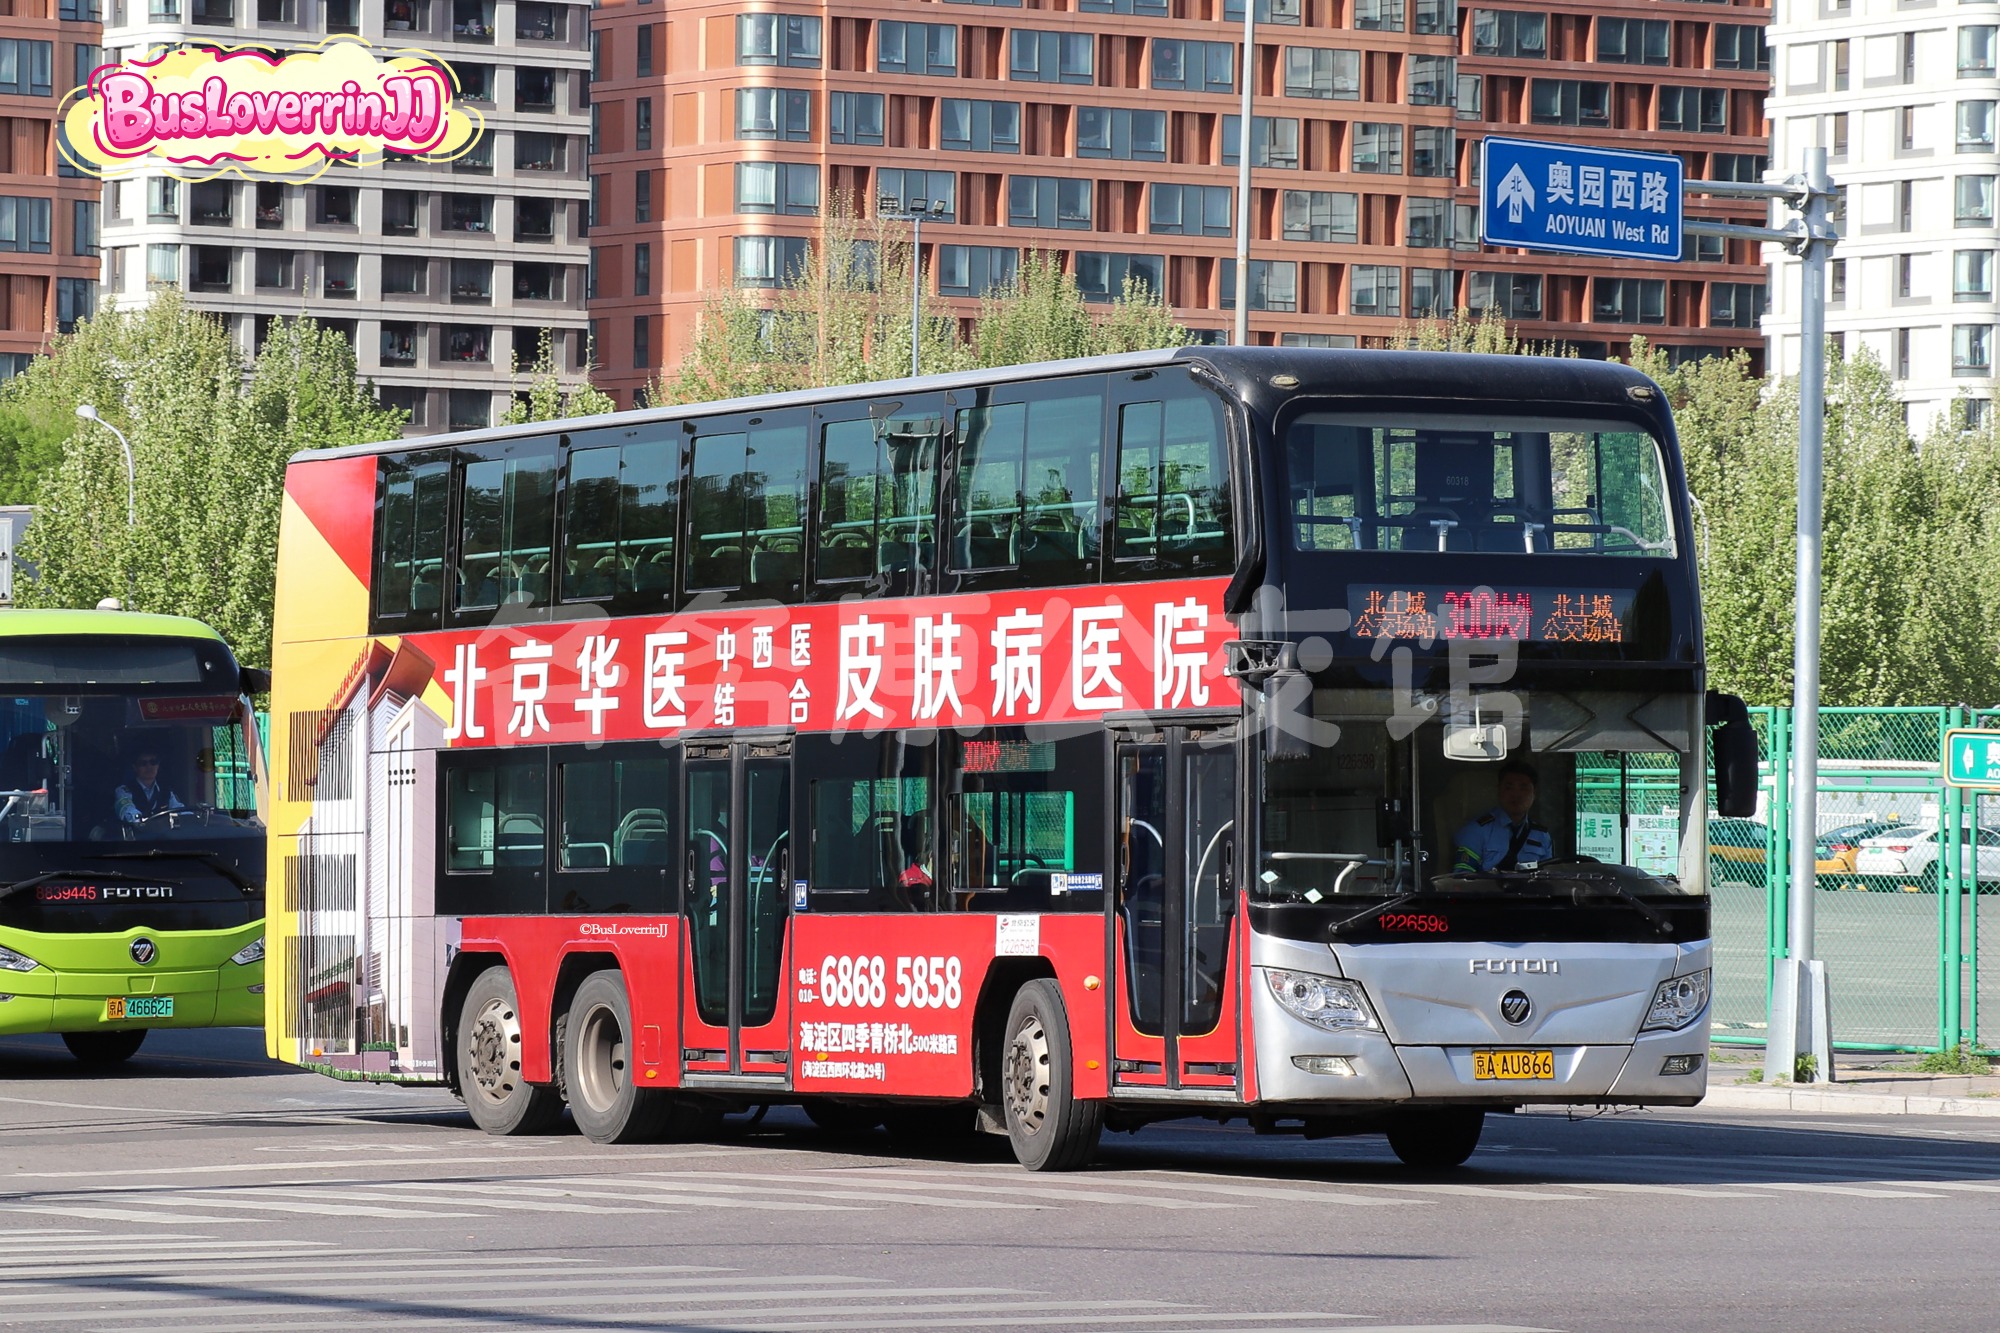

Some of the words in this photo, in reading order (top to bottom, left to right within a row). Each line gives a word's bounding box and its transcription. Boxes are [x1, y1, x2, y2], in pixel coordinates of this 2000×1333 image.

[1511, 175, 1522, 193] 北
[1546, 160, 1669, 214] 奥园西路
[1512, 204, 1520, 217] N
[1545, 214, 1606, 238] AOYUAN
[1612, 220, 1645, 242] West
[1651, 224, 1669, 244] Rd
[1446, 476, 1469, 486] 60318
[1364, 590, 1427, 615] 北土城
[1552, 594, 1613, 619] 北土城
[1354, 614, 1437, 639] 公交场站
[1541, 618, 1623, 643] 公交场站
[716, 622, 812, 673] 中西医
[835, 596, 1209, 721] 皮肤病医院
[443, 630, 689, 740] 北京华医
[714, 677, 811, 726] 结合
[36, 886, 97, 900] 8839445
[103, 886, 173, 899] FOTON
[1378, 914, 1448, 932] 1226598
[1469, 957, 1559, 974] FOTON
[820, 955, 886, 1008] 6868
[894, 955, 962, 1009] 5858
